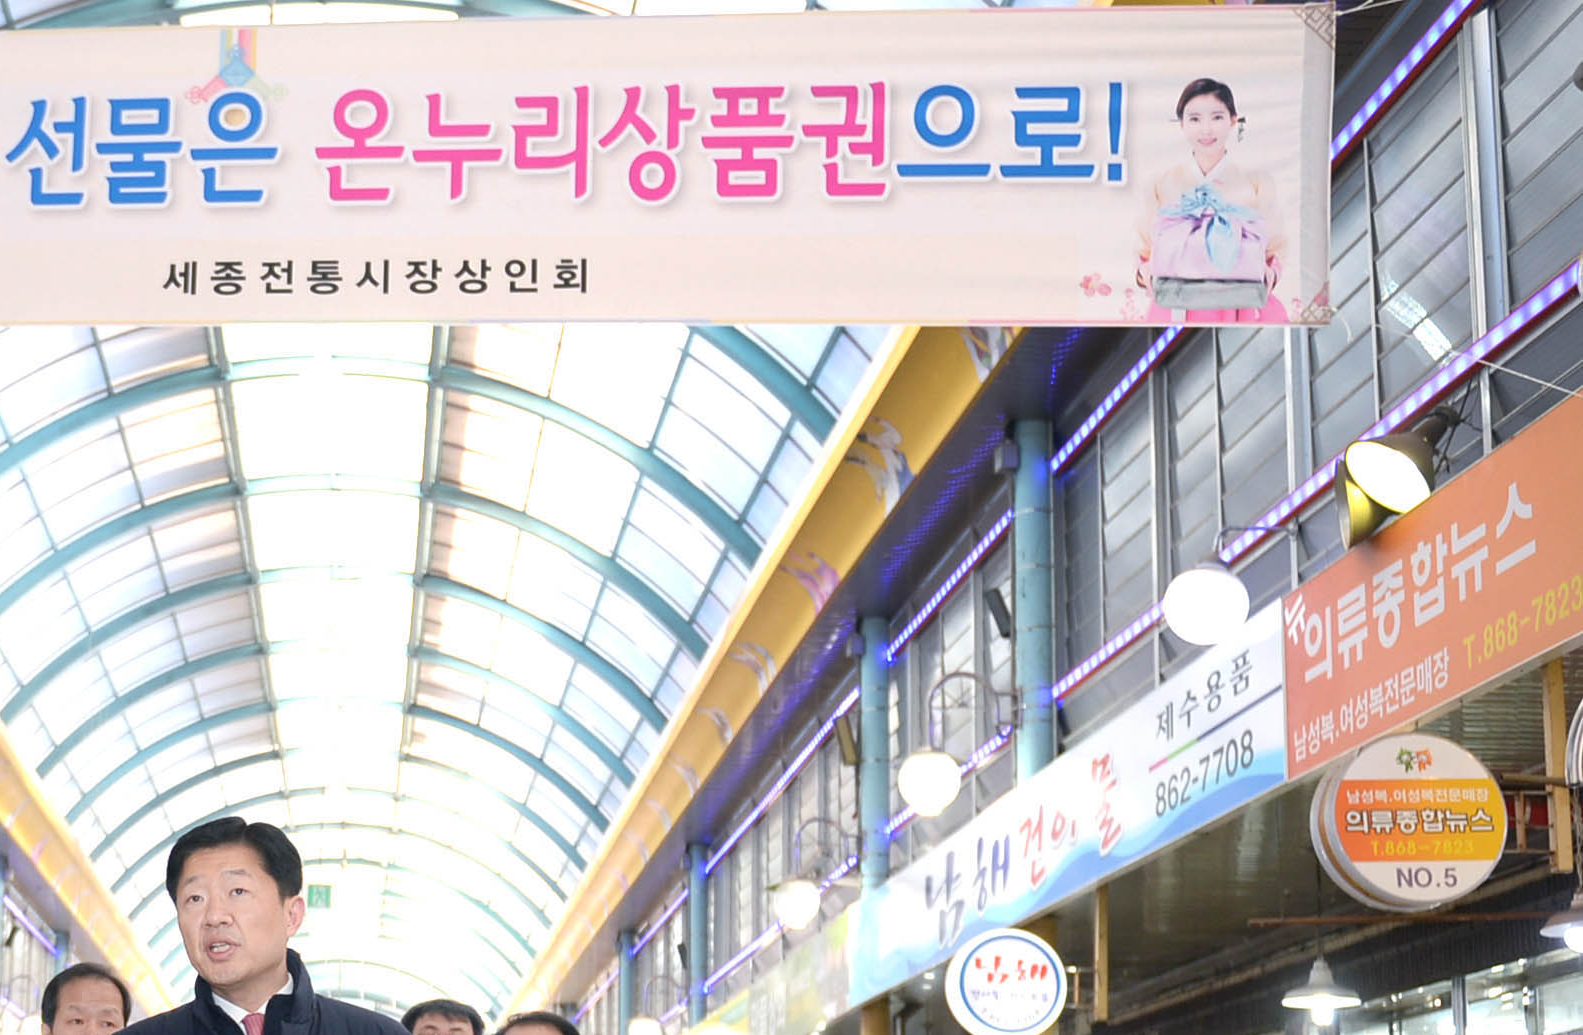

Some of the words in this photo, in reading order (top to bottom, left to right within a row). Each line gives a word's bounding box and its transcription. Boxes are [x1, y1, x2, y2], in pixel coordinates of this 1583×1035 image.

[315, 81, 1123, 202] 온누리상품권으로!
[161, 257, 590, 295] 세종전통시장상인회
[1155, 648, 1253, 742] 제수용품
[1292, 646, 1451, 763] 남성복.여성복전문매장
[1462, 574, 1583, 670] T.868-7823
[1154, 729, 1255, 818] 862-7708
[1344, 808, 1495, 835] 의류종합뉴스
[1395, 866, 1458, 889] NO.5
